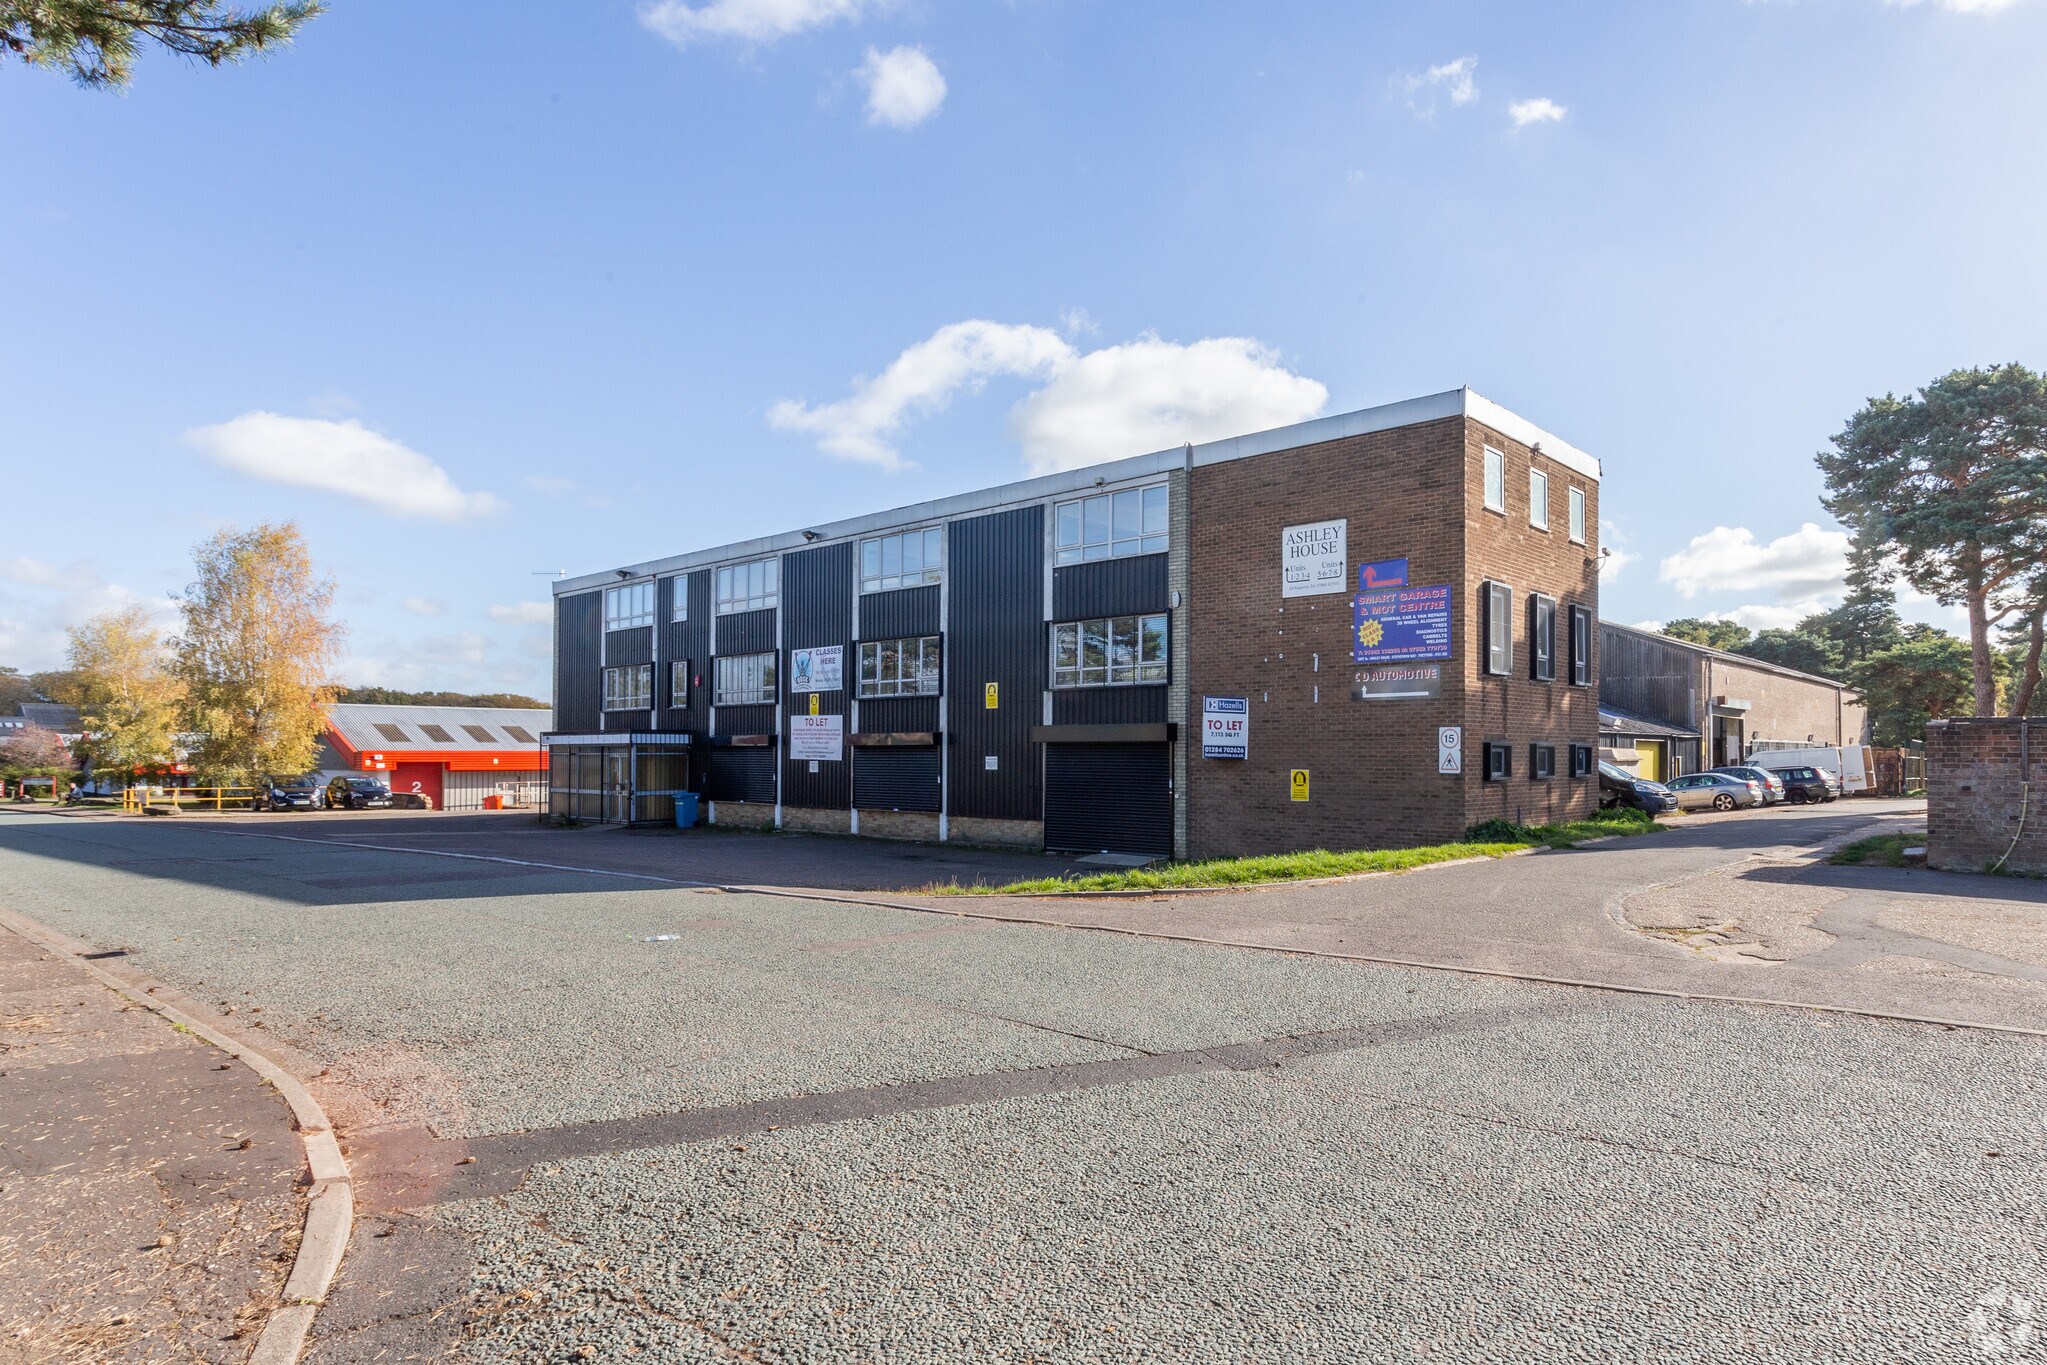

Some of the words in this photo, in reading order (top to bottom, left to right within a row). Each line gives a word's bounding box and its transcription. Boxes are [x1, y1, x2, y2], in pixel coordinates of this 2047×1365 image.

[1286, 526, 1342, 545] ASHLEY
[1290, 540, 1338, 558] HOUSE
[1322, 560, 1338, 568] Units
[1358, 594, 1396, 605] SMART
[1400, 589, 1447, 601] GARAGE
[1361, 608, 1368, 616] &
[1372, 605, 1396, 615] MOT
[1399, 601, 1446, 612] CENTRE
[1362, 623, 1374, 632] MOT
[1362, 628, 1380, 639] CLASS
[816, 647, 841, 656] CLASSES
[1355, 672, 1361, 682] C
[1362, 672, 1370, 682] D
[1372, 668, 1437, 682] AUTOMOTIVE
[1219, 701, 1242, 709] Hazells
[805, 718, 814, 726] TO
[816, 718, 828, 726] LET
[1208, 720, 1222, 730] TO
[1226, 720, 1243, 730] LET
[1444, 734, 1454, 743] 15
[411, 782, 422, 793] 2
